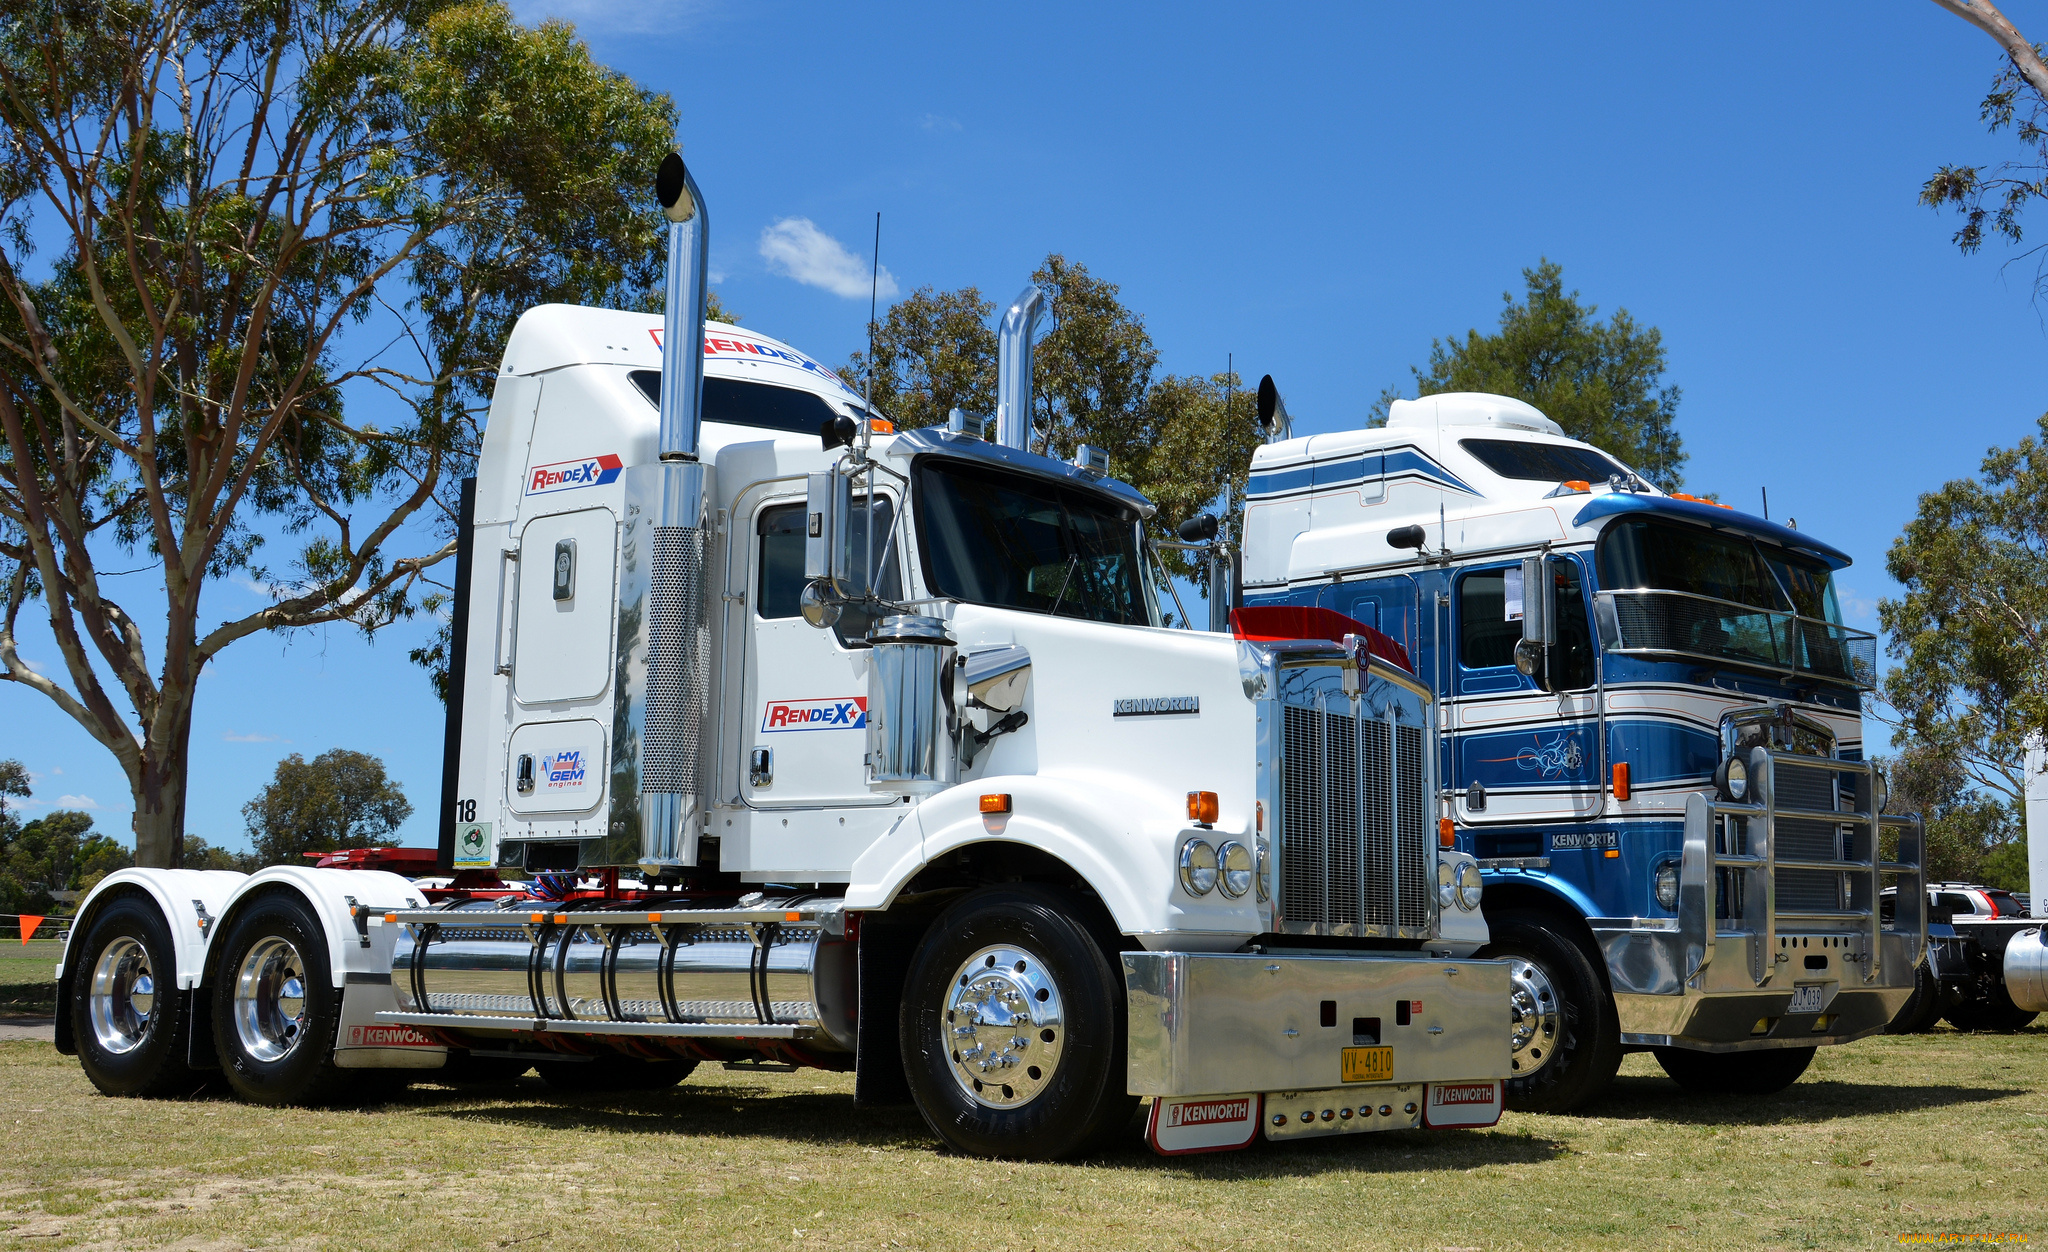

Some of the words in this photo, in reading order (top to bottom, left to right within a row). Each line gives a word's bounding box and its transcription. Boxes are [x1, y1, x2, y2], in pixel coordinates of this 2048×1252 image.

[1113, 696, 1199, 713] KENWORTH
[556, 751, 580, 770] HM
[550, 770, 585, 781] GEM
[457, 799, 476, 823] 18
[1552, 832, 1616, 847] KENWORTH
[367, 1029, 433, 1043] KENWOR
[1445, 1088, 1492, 1101] KENWORTH
[1184, 1103, 1247, 1122] KENWORTH
